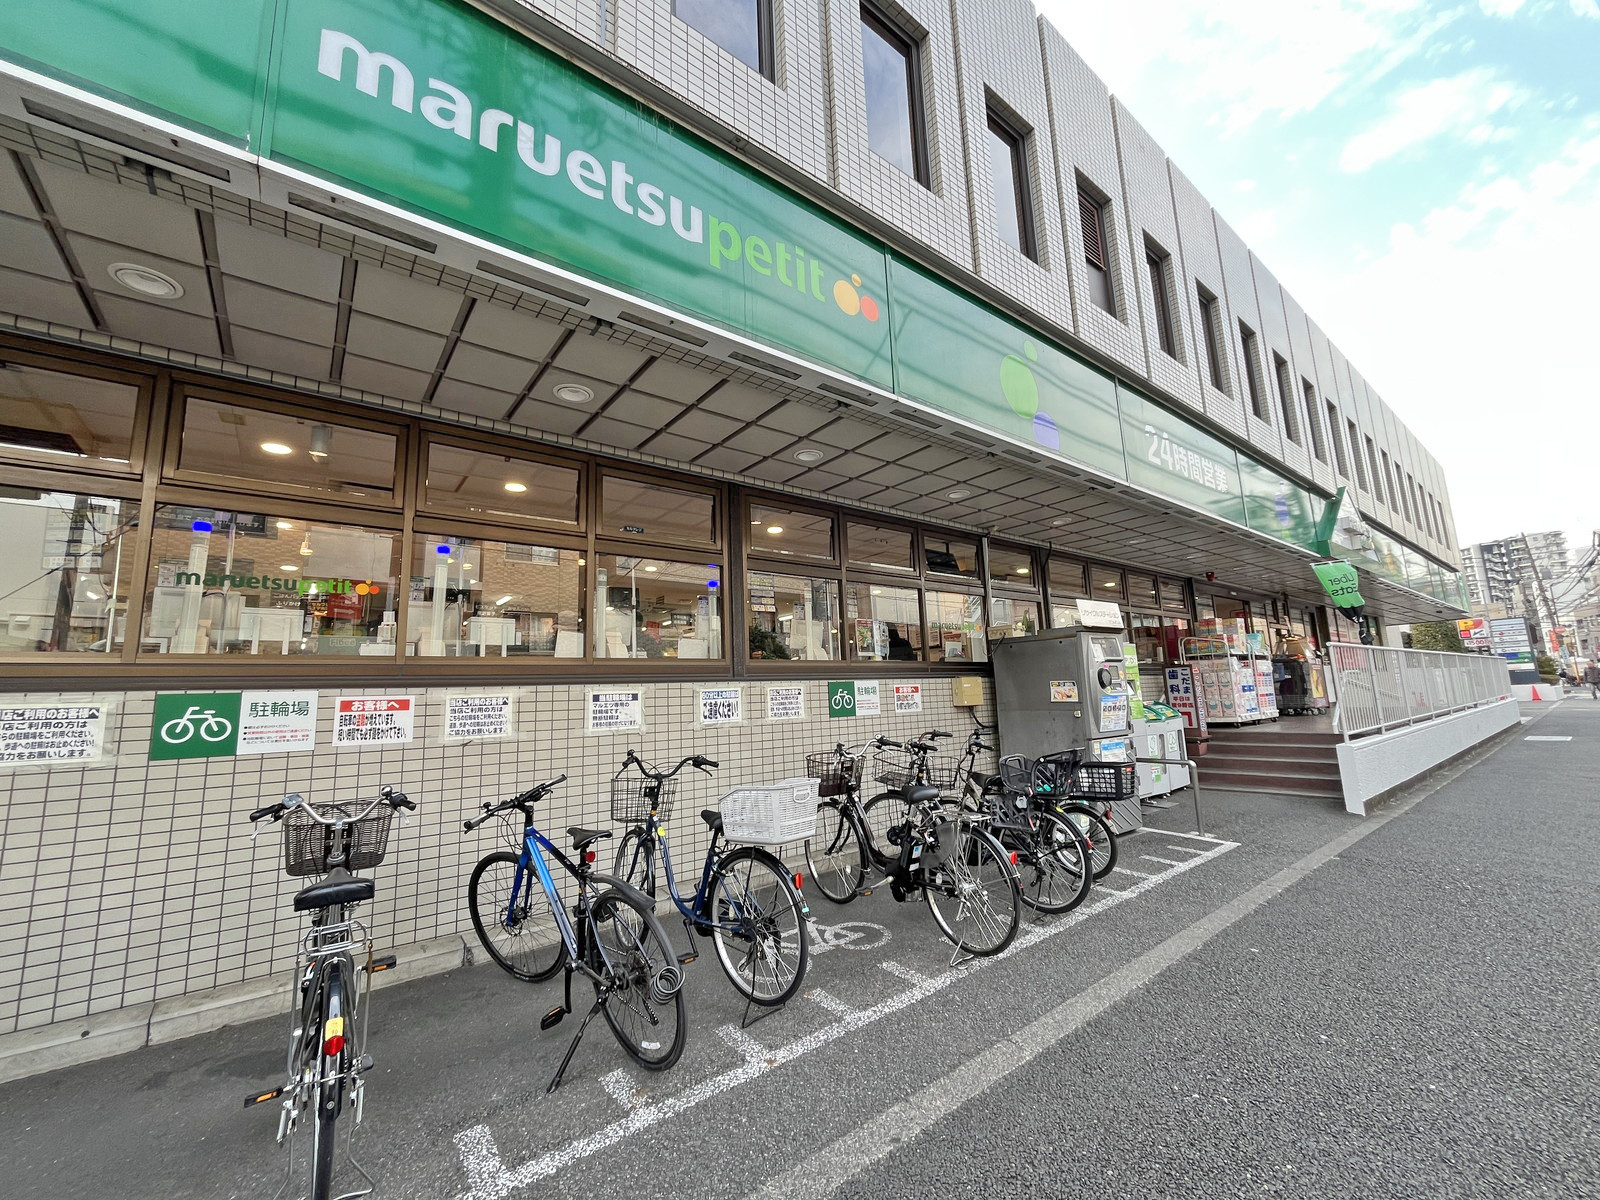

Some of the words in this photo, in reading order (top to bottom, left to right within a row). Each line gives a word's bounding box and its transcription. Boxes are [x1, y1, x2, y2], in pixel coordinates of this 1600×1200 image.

[1144, 424, 1229, 494] 24時間営業
[1168, 669, 1180, 694] 歯科
[1181, 668, 1191, 694] こだま
[0, 707, 99, 720] 店ご利用のお客様へ
[249, 701, 310, 718] 駐輪場
[351, 700, 399, 711] お客様へ
[0, 721, 88, 731] 店ご利用の方は
